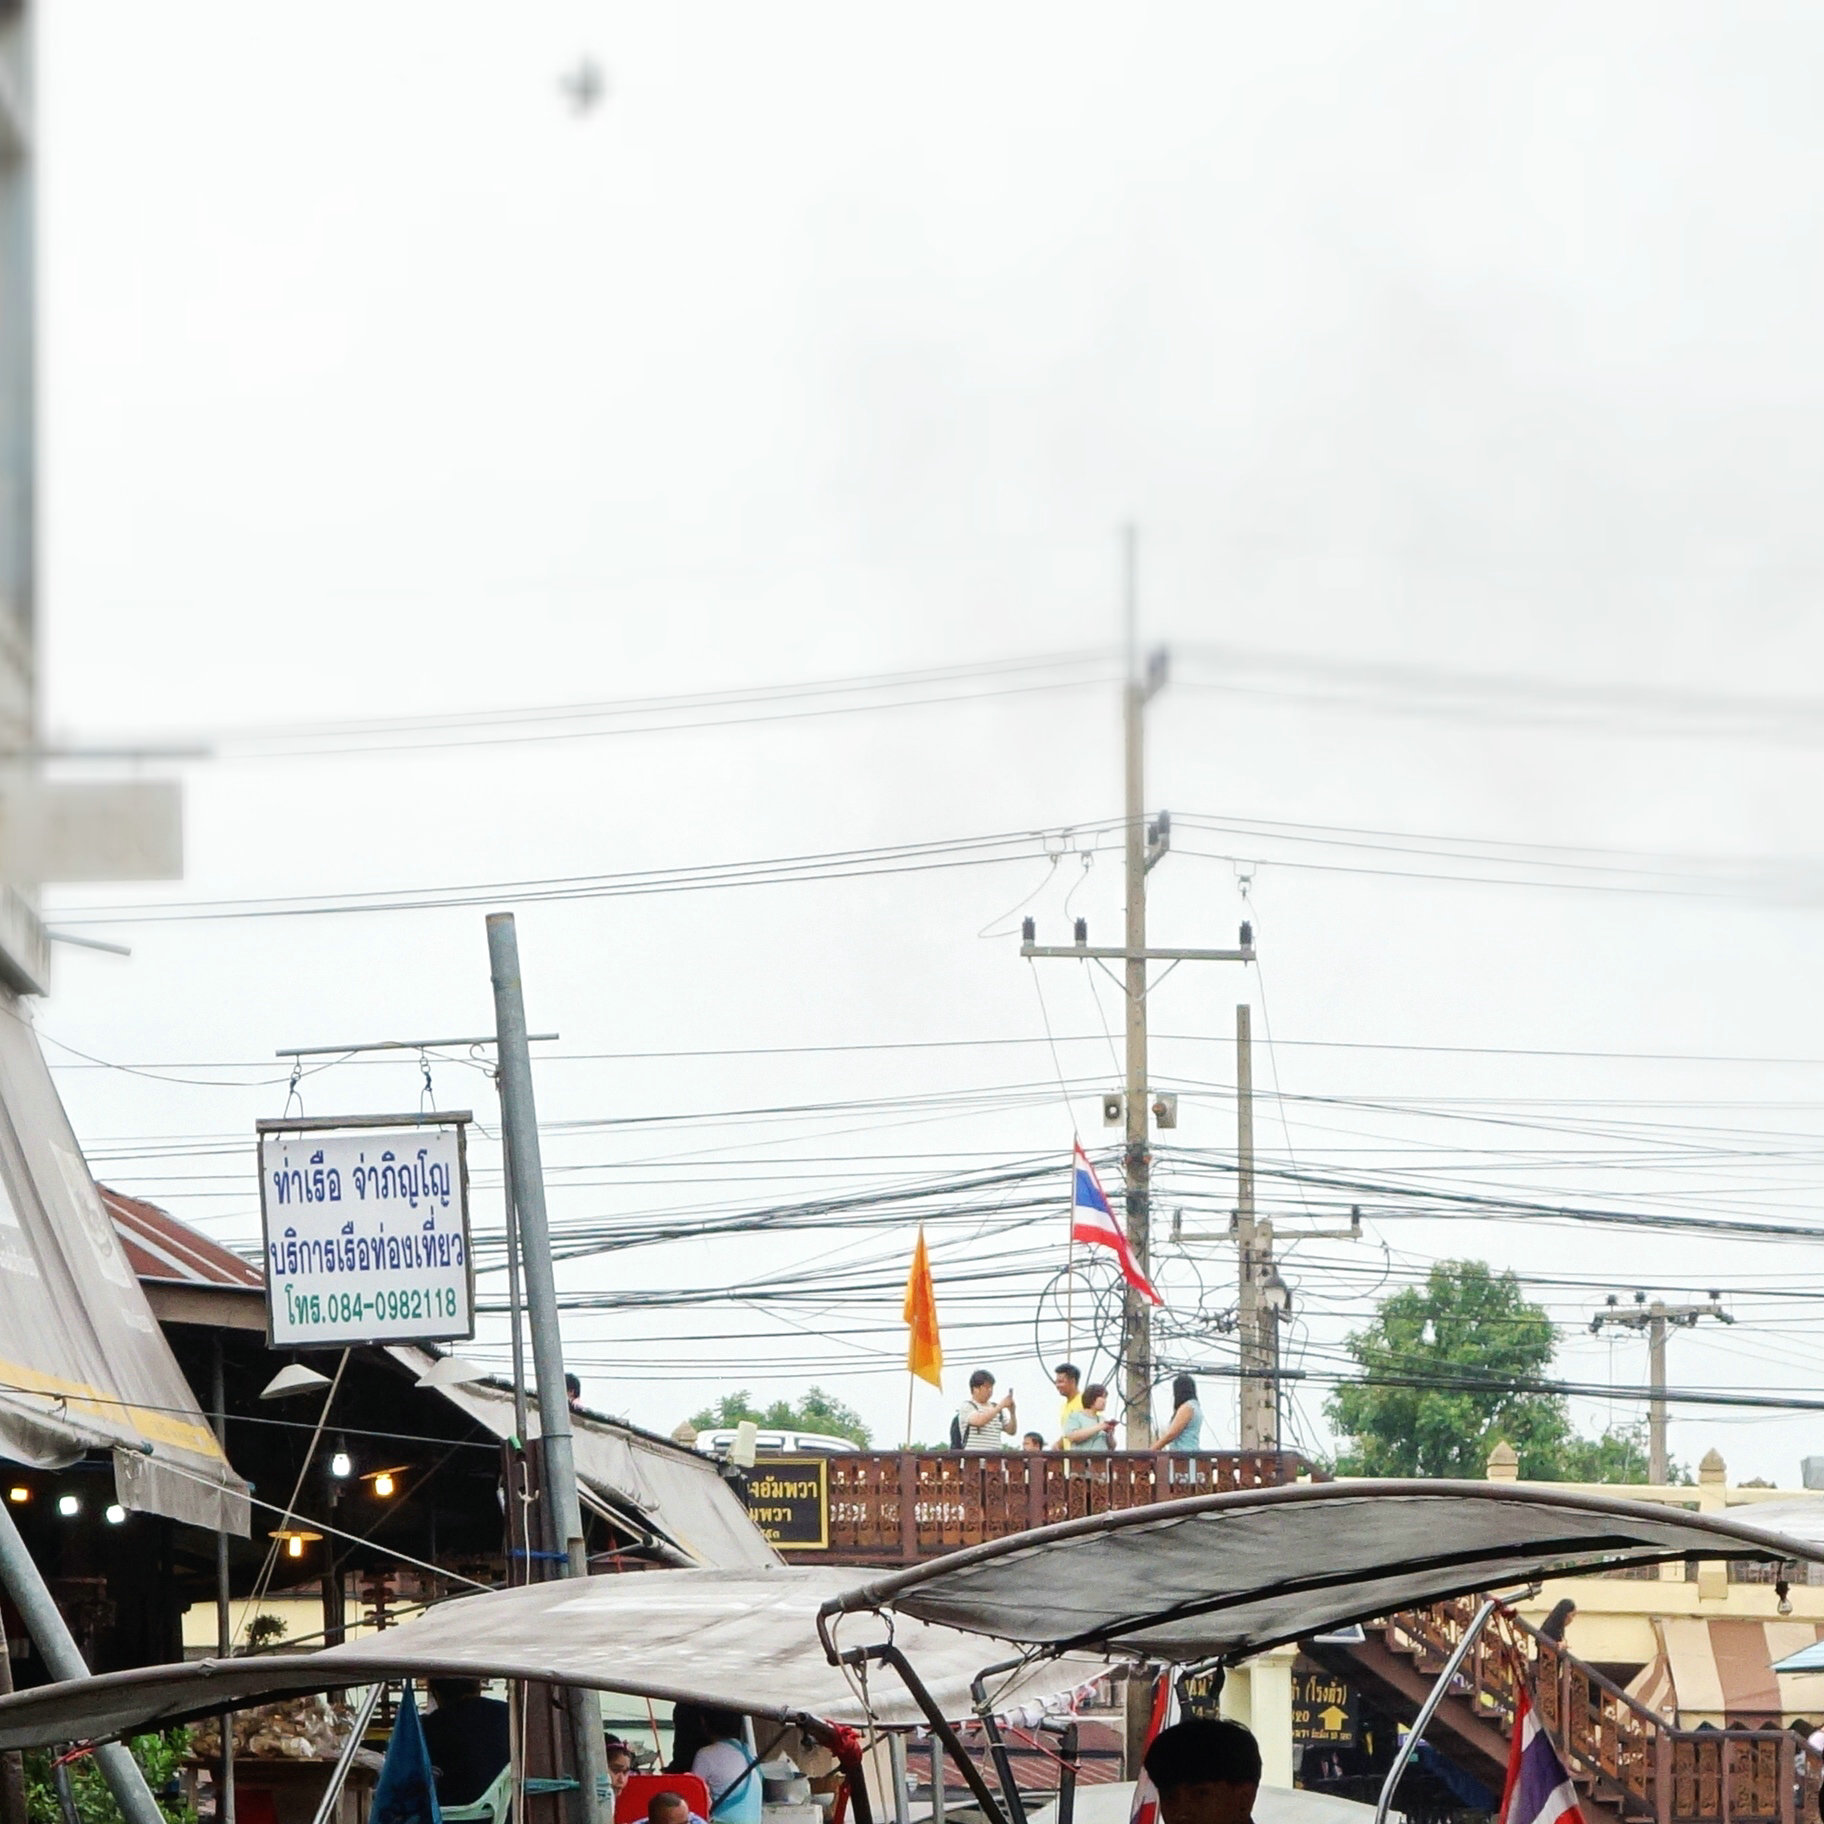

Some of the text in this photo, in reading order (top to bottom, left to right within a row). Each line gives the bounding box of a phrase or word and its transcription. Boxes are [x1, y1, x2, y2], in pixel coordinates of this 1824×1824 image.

[273, 1149, 342, 1205] ท่าเรือ
[269, 1205, 464, 1276] บริการเรือท่องเที่ยว
